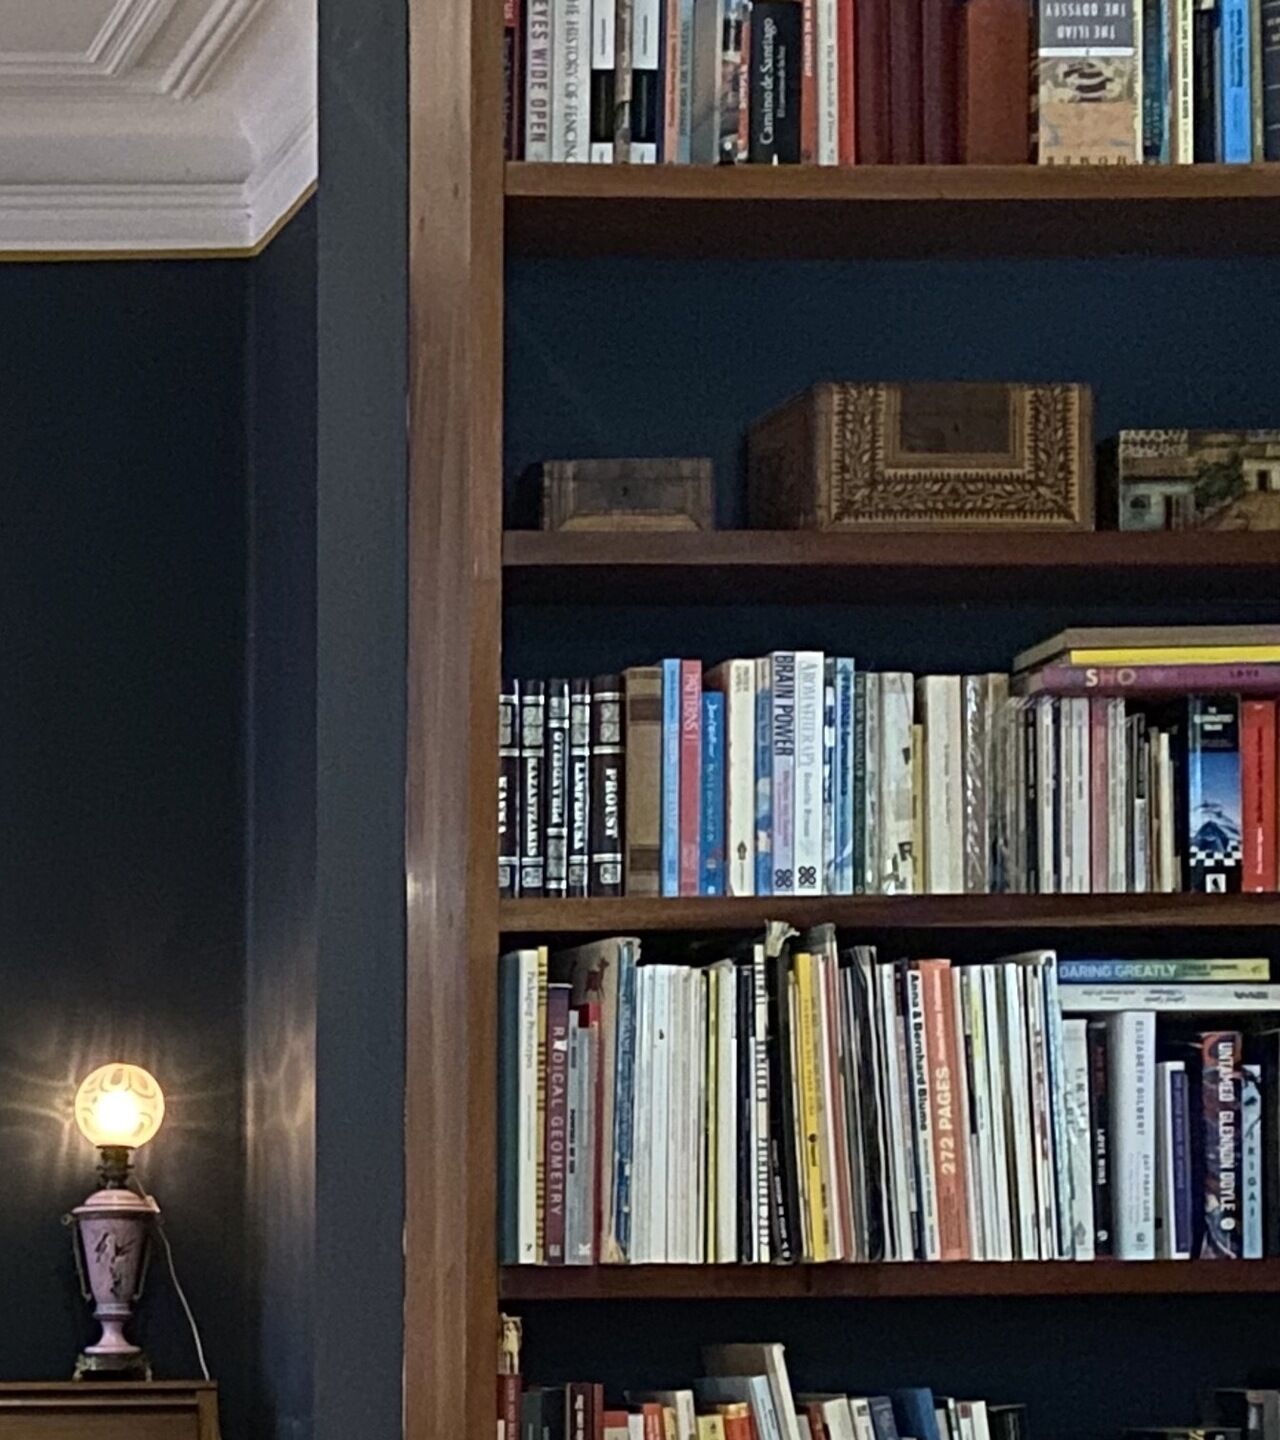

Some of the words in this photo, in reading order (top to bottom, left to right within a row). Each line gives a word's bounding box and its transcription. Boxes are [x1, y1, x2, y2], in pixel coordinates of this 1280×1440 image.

[1045, 5, 1098, 18] ODYSSEY
[1056, 25, 1093, 39] ILIAD
[1100, 25, 1115, 39] THE
[1105, 5, 1127, 17] THE
[564, 20, 578, 77] HISTORY
[760, 18, 778, 74] Santiago
[531, 49, 548, 90] WIDE
[565, 82, 578, 99] OF
[761, 74, 775, 87] de
[530, 100, 547, 143] OPEN
[760, 88, 775, 145] Camino
[775, 655, 794, 699] BRAIN
[775, 704, 794, 756] POWER
[799, 660, 817, 768] AROMATHERAPY
[552, 732, 563, 823] PIRANDELLO
[527, 757, 538, 856] KAZANTZAKIS
[573, 763, 584, 849] LAMPEDUSA
[605, 768, 618, 838] PROUST
[910, 974, 919, 1004] Anna
[1060, 965, 1111, 979] DARING
[1114, 965, 1177, 979] GREATLY
[912, 1007, 920, 1016] &
[551, 1026, 565, 1107] RDICAL
[913, 1020, 926, 1087] Bernhard
[1135, 1020, 1144, 1084] ELIZABETH
[1217, 1042, 1234, 1102] UNTAMED
[918, 1089, 928, 1132] Blume
[938, 1067, 954, 1131] PAGES
[1135, 1087, 1144, 1136] GILBERT
[940, 1136, 956, 1176] 272
[1097, 1128, 1106, 1157] LOVE
[1217, 1110, 1234, 1170] GLENNON
[550, 1116, 564, 1216] GEOMETRY
[1097, 1160, 1106, 1185] WINS
[1217, 1171, 1234, 1213] DOYLE
